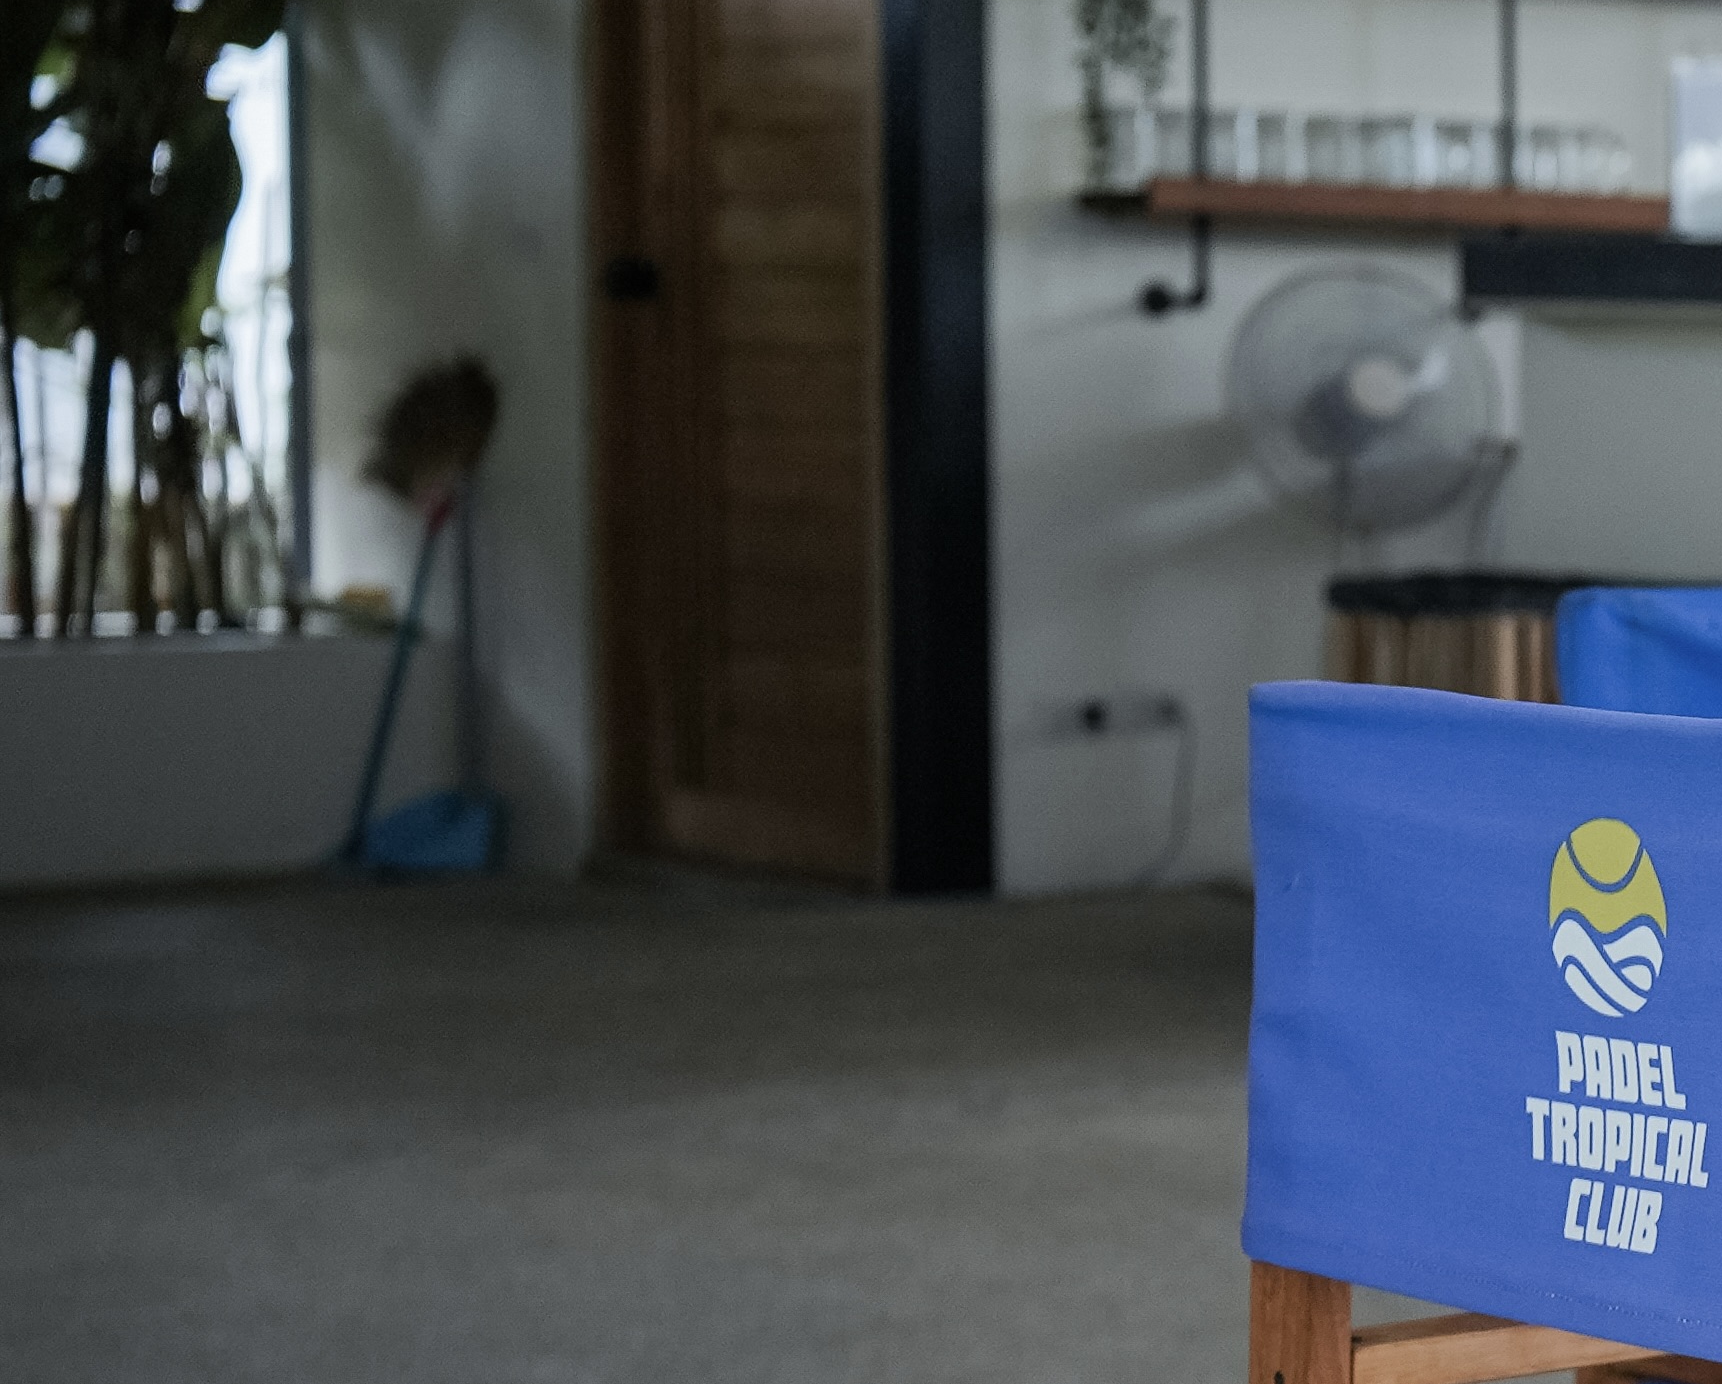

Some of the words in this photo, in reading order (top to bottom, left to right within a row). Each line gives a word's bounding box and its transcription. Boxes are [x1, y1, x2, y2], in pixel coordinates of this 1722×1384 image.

[1555, 1030, 1687, 1110] PADEL
[1526, 1097, 1709, 1188] TROPICAL
[1563, 1178, 1663, 1254] CLUB
